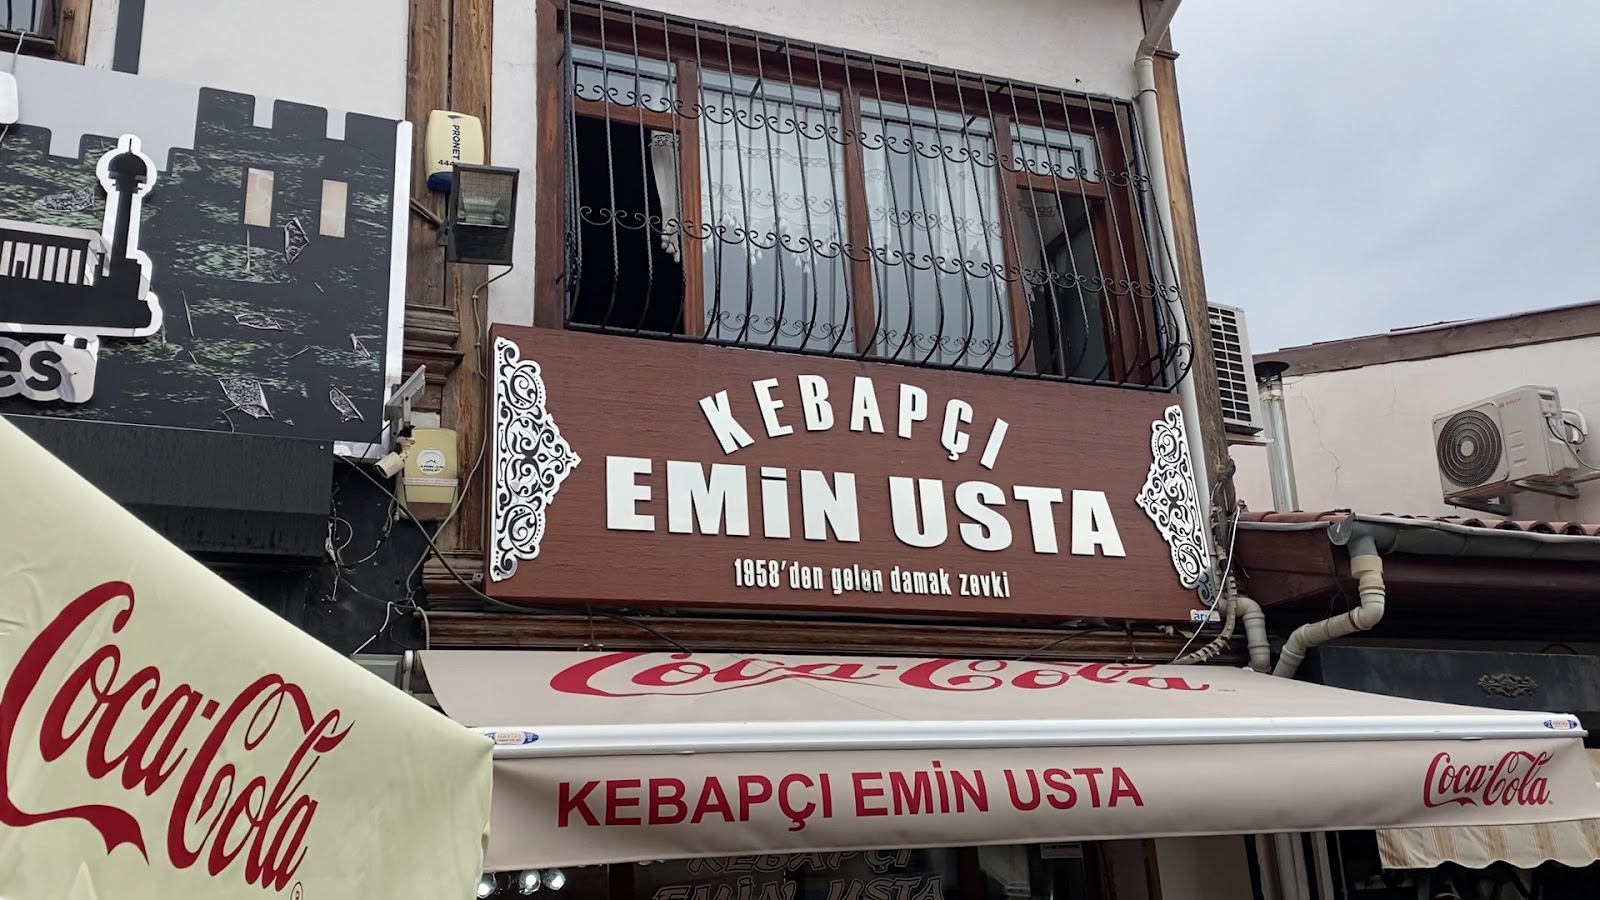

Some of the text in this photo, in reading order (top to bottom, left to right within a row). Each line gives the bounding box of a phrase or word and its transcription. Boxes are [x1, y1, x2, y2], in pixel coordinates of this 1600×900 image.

[452, 124, 461, 161] PRONET
[699, 374, 1009, 470] KEBAPÇI
[889, 477, 1127, 558] USTA
[734, 558, 1011, 598] 1958'den gelen damak zevki
[549, 651, 1211, 698] Coca-Cola
[0, 580, 356, 892] Coca-Cola
[557, 760, 1145, 832] KEBAPÇI EMİN USTA
[1423, 751, 1555, 808] Coca-Cola
